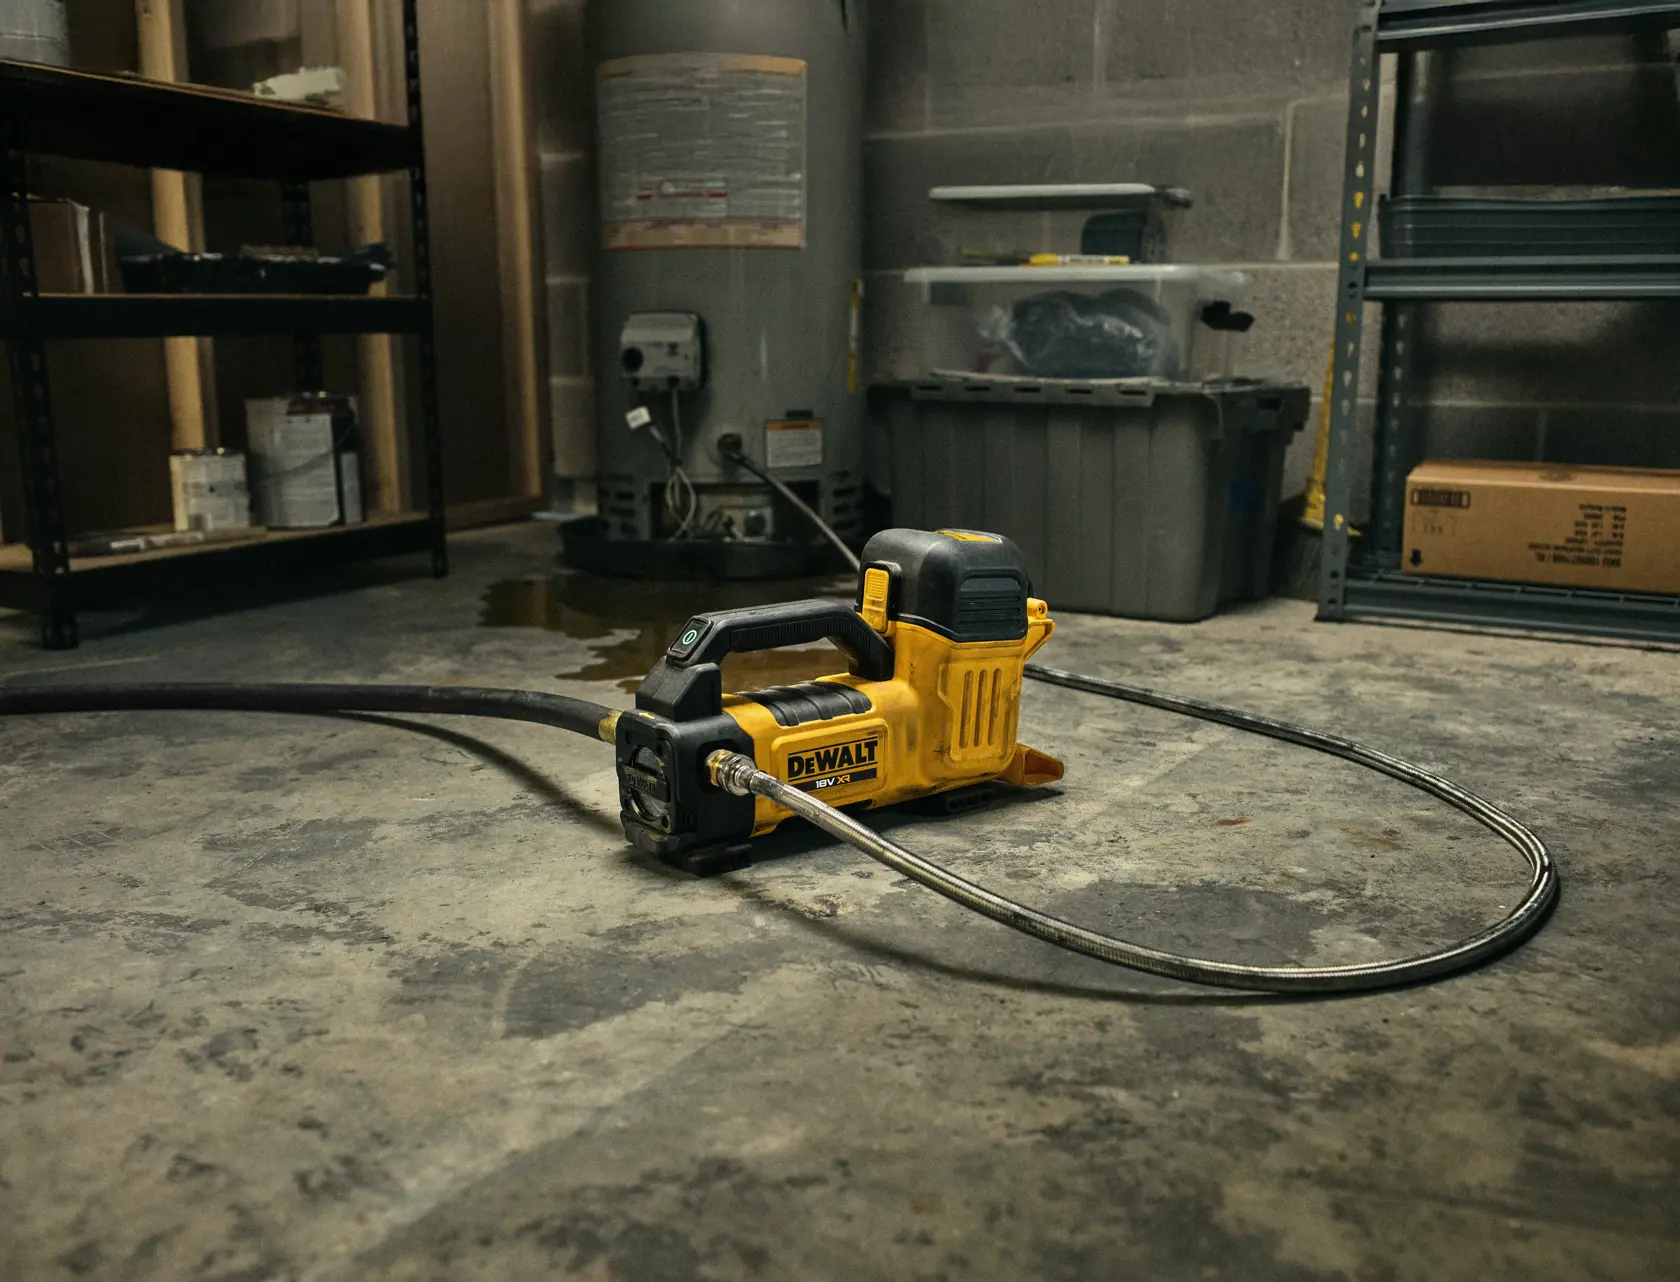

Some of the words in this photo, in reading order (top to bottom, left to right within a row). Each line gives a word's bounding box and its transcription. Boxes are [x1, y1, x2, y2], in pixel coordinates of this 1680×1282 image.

[788, 740, 878, 778] DEWALT
[816, 777, 835, 788] 18V
[837, 774, 851, 785] XR
